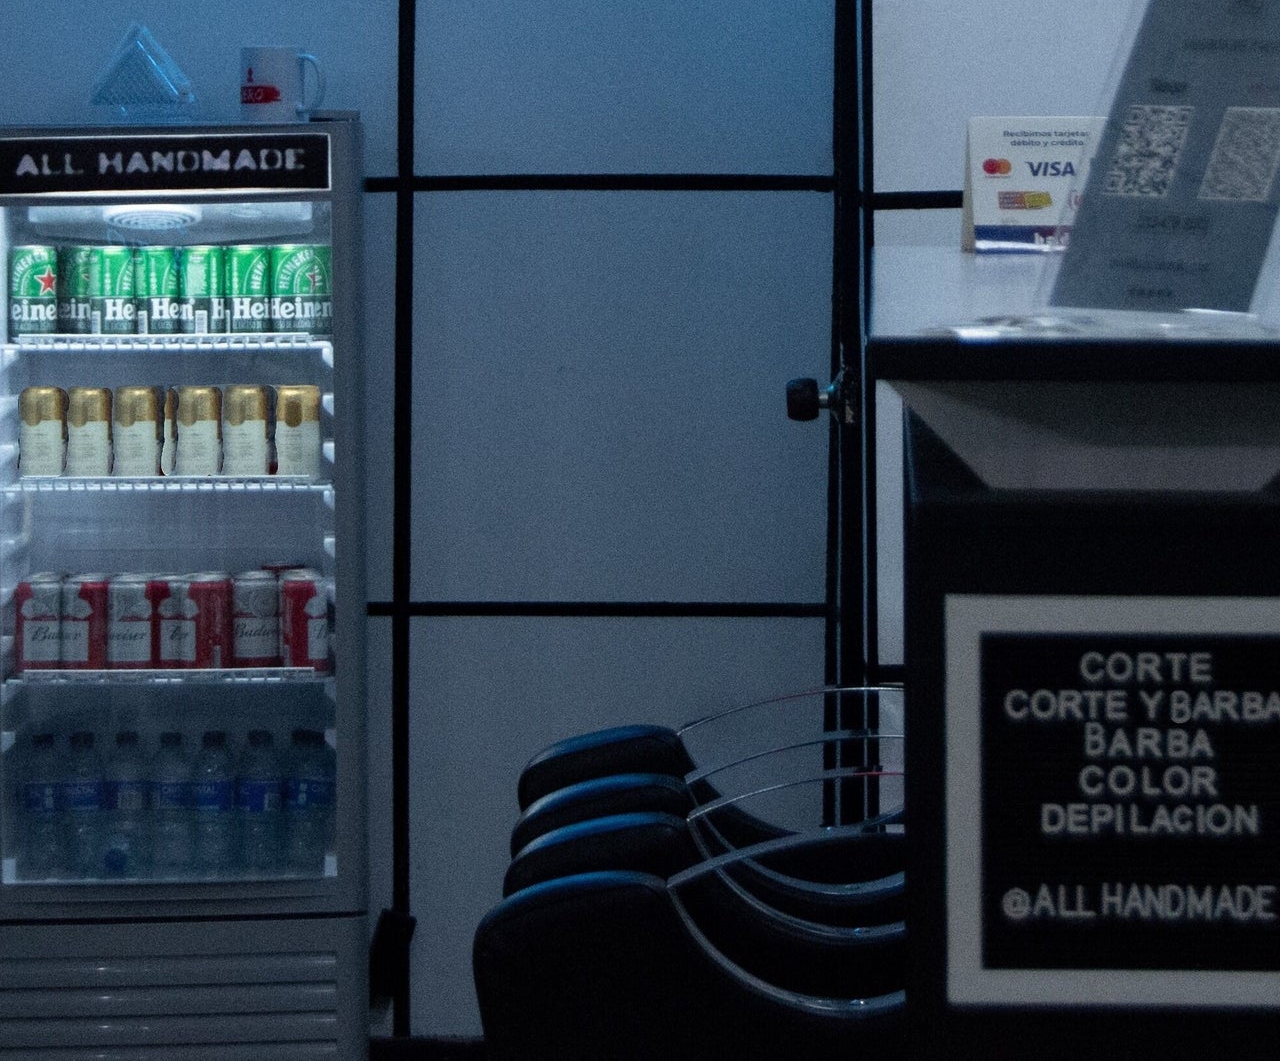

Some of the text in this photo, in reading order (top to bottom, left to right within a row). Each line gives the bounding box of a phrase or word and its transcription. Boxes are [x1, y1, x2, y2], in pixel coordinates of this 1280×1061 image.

[1002, 130, 1052, 138] Recibimos
[1010, 138, 1085, 148] débito y crédito
[15, 146, 306, 178] ALL HANDMADE
[1025, 161, 1076, 177] VISA
[1079, 651, 1214, 684] CORTE
[1003, 689, 1130, 720] CORTE
[1140, 690, 1164, 720] Y
[1084, 721, 1216, 759] BARBA
[1078, 765, 1219, 798] COLOR
[1040, 803, 1261, 836] DEPILACION
[1001, 882, 1279, 920] @ALL HANDMADE
